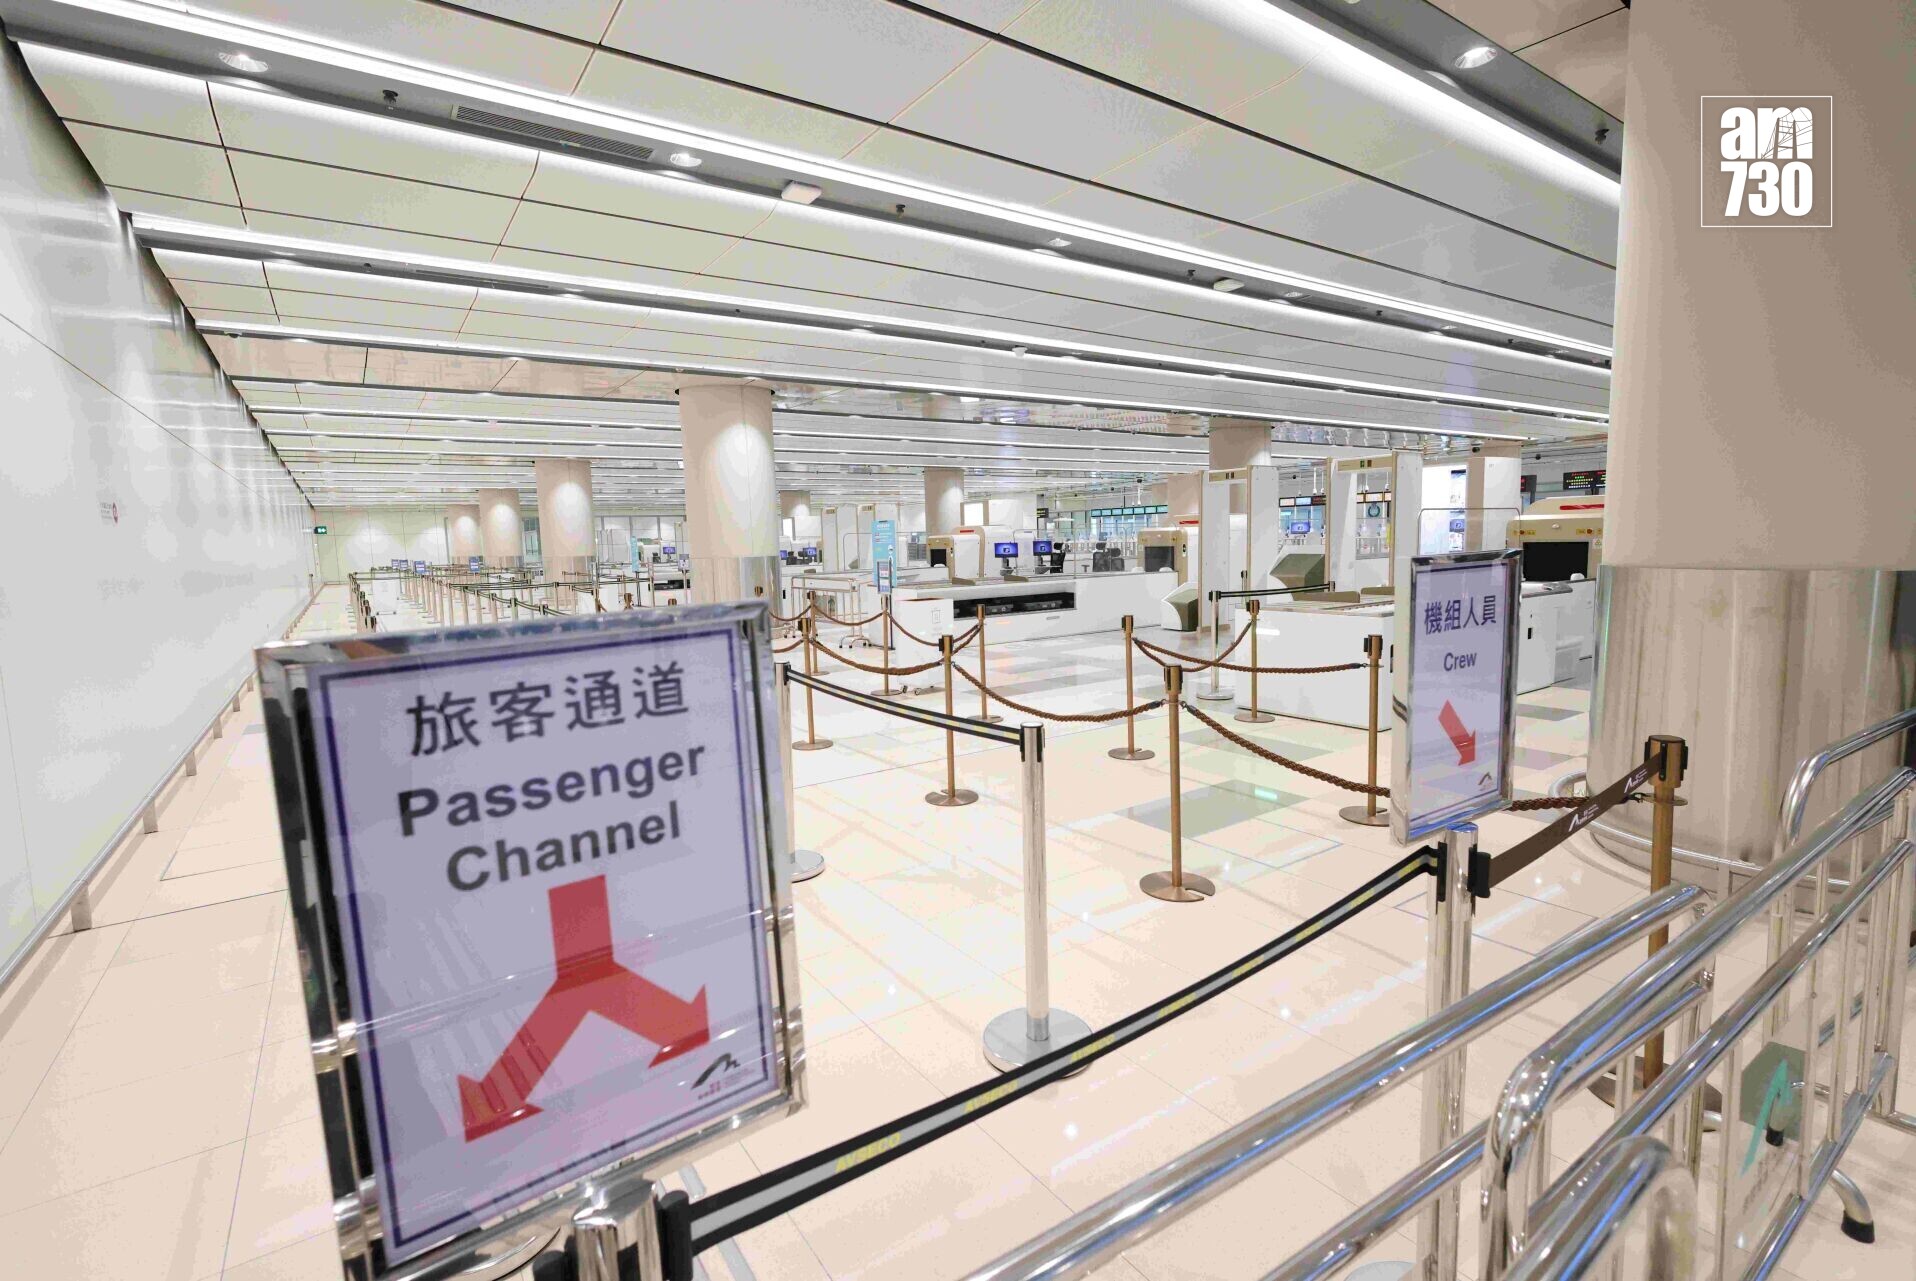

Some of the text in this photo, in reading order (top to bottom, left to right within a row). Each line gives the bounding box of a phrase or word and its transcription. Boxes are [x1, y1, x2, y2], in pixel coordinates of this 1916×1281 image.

[1424, 594, 1497, 636] 機組人員
[1443, 650, 1477, 672] Crew
[406, 660, 689, 757] 旅客通道
[397, 743, 706, 837] Passenger
[446, 800, 681, 892] Channel
